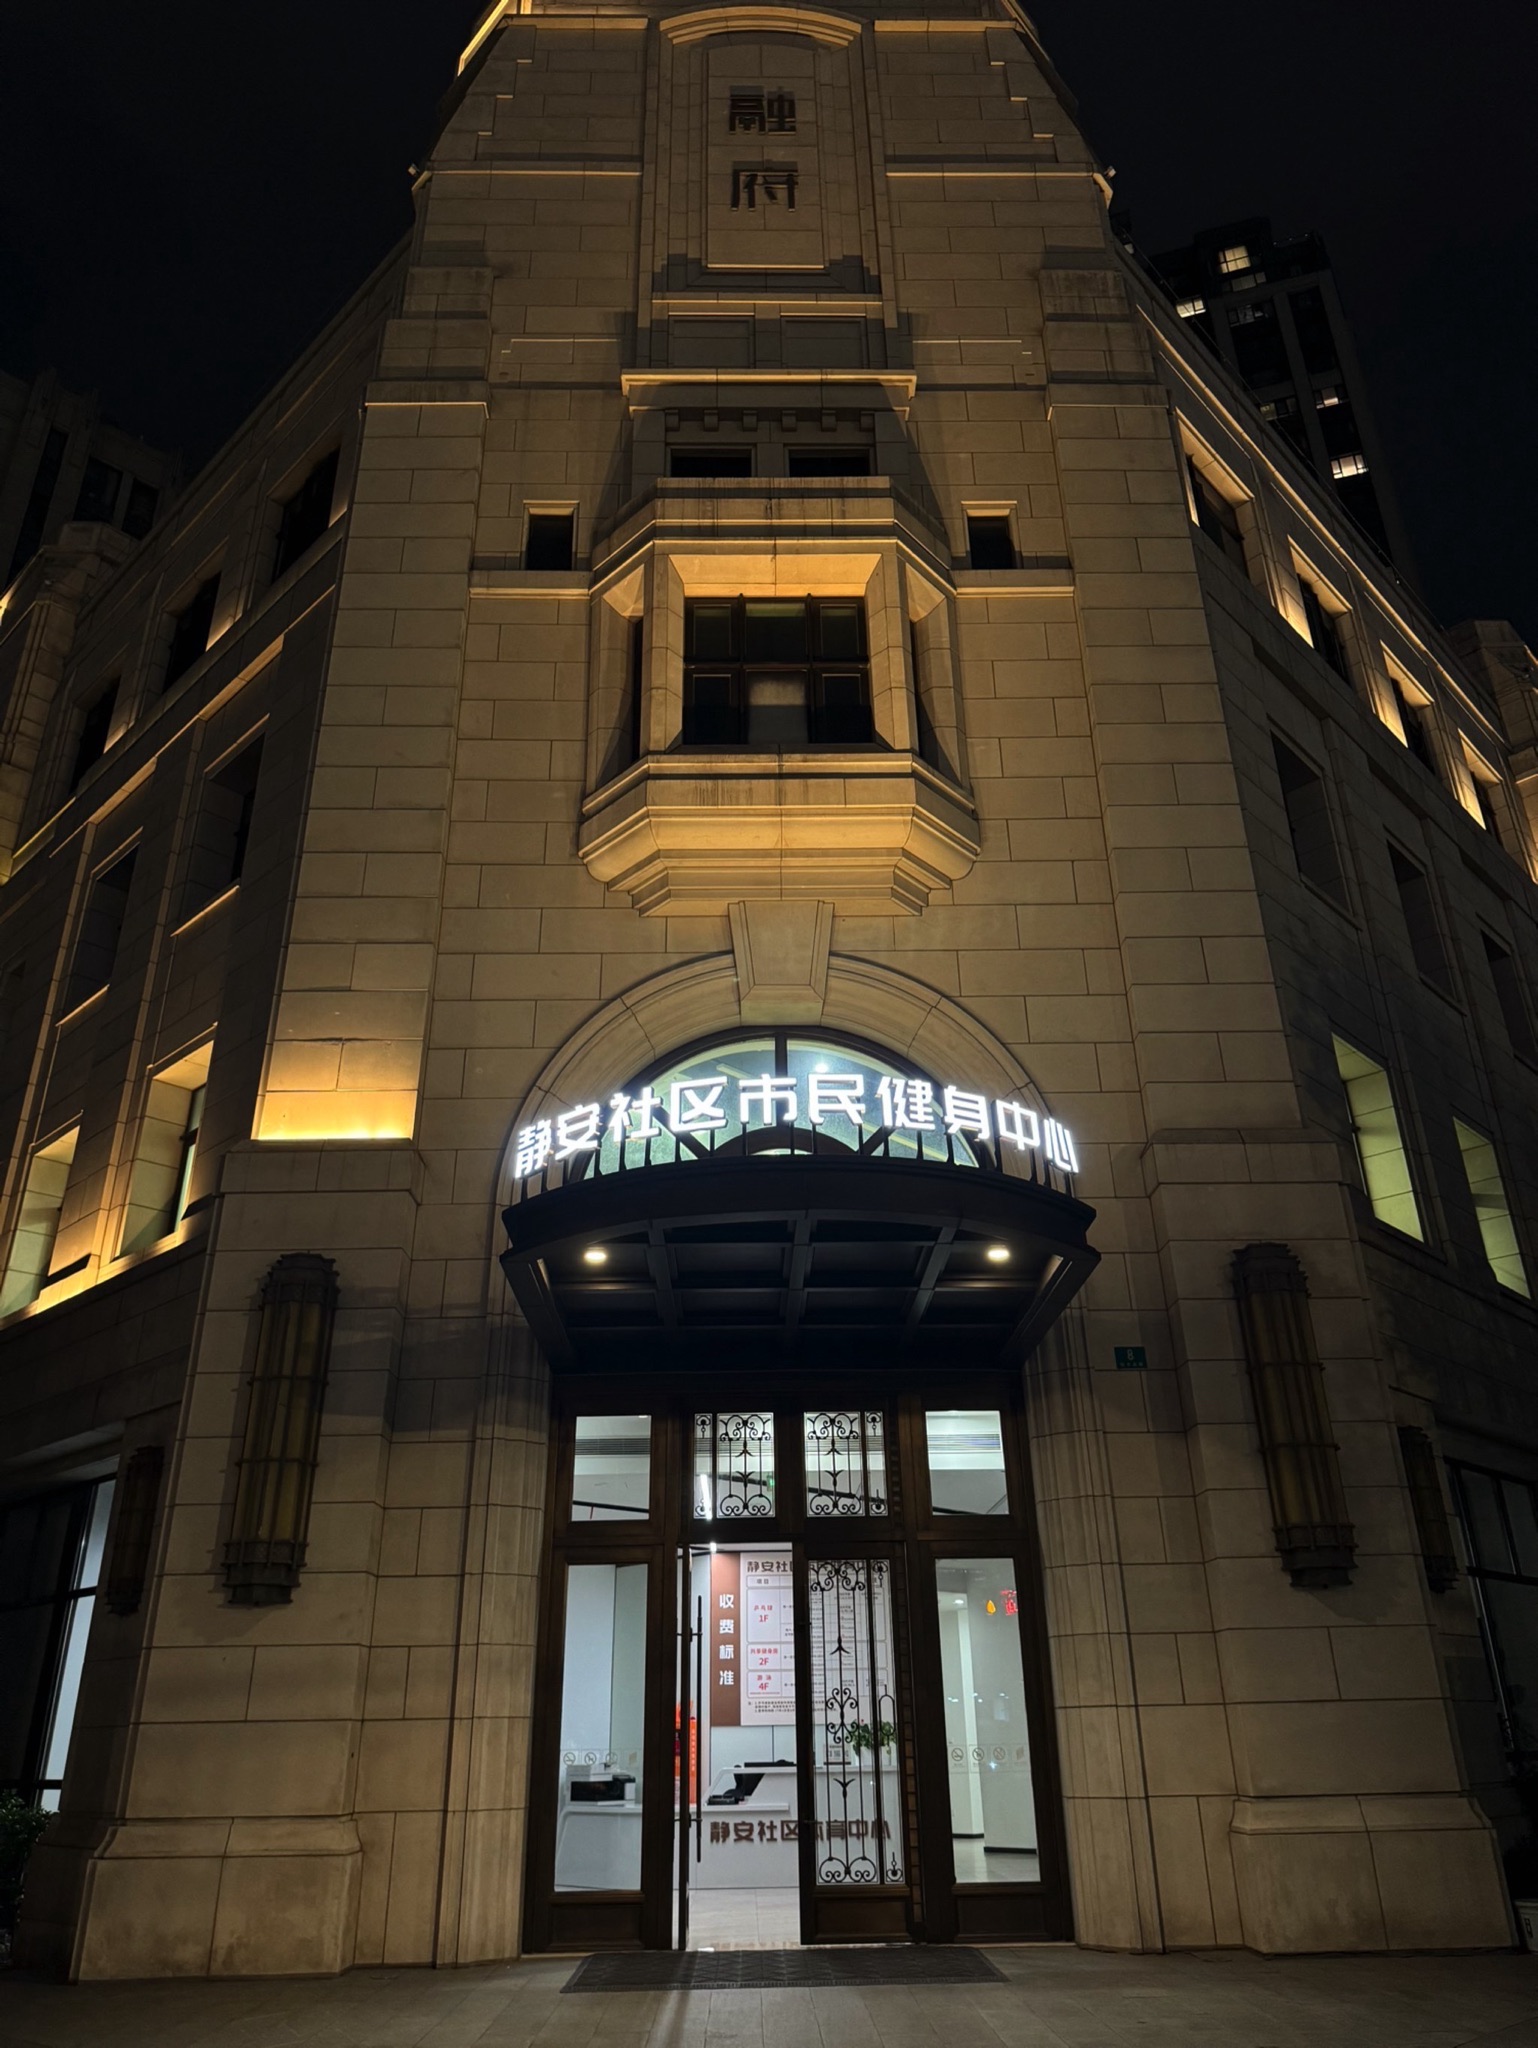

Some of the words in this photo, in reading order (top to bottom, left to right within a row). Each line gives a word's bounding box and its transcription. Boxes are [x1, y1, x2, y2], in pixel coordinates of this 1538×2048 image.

[514, 1073, 1080, 1180] 静安社区市民健身中心
[747, 1561, 793, 1573] 静安社
[759, 1614, 769, 1623] 1F
[719, 1593, 734, 1686] 收费标准
[759, 1657, 769, 1666] 2F
[758, 1682, 769, 1691] 4F
